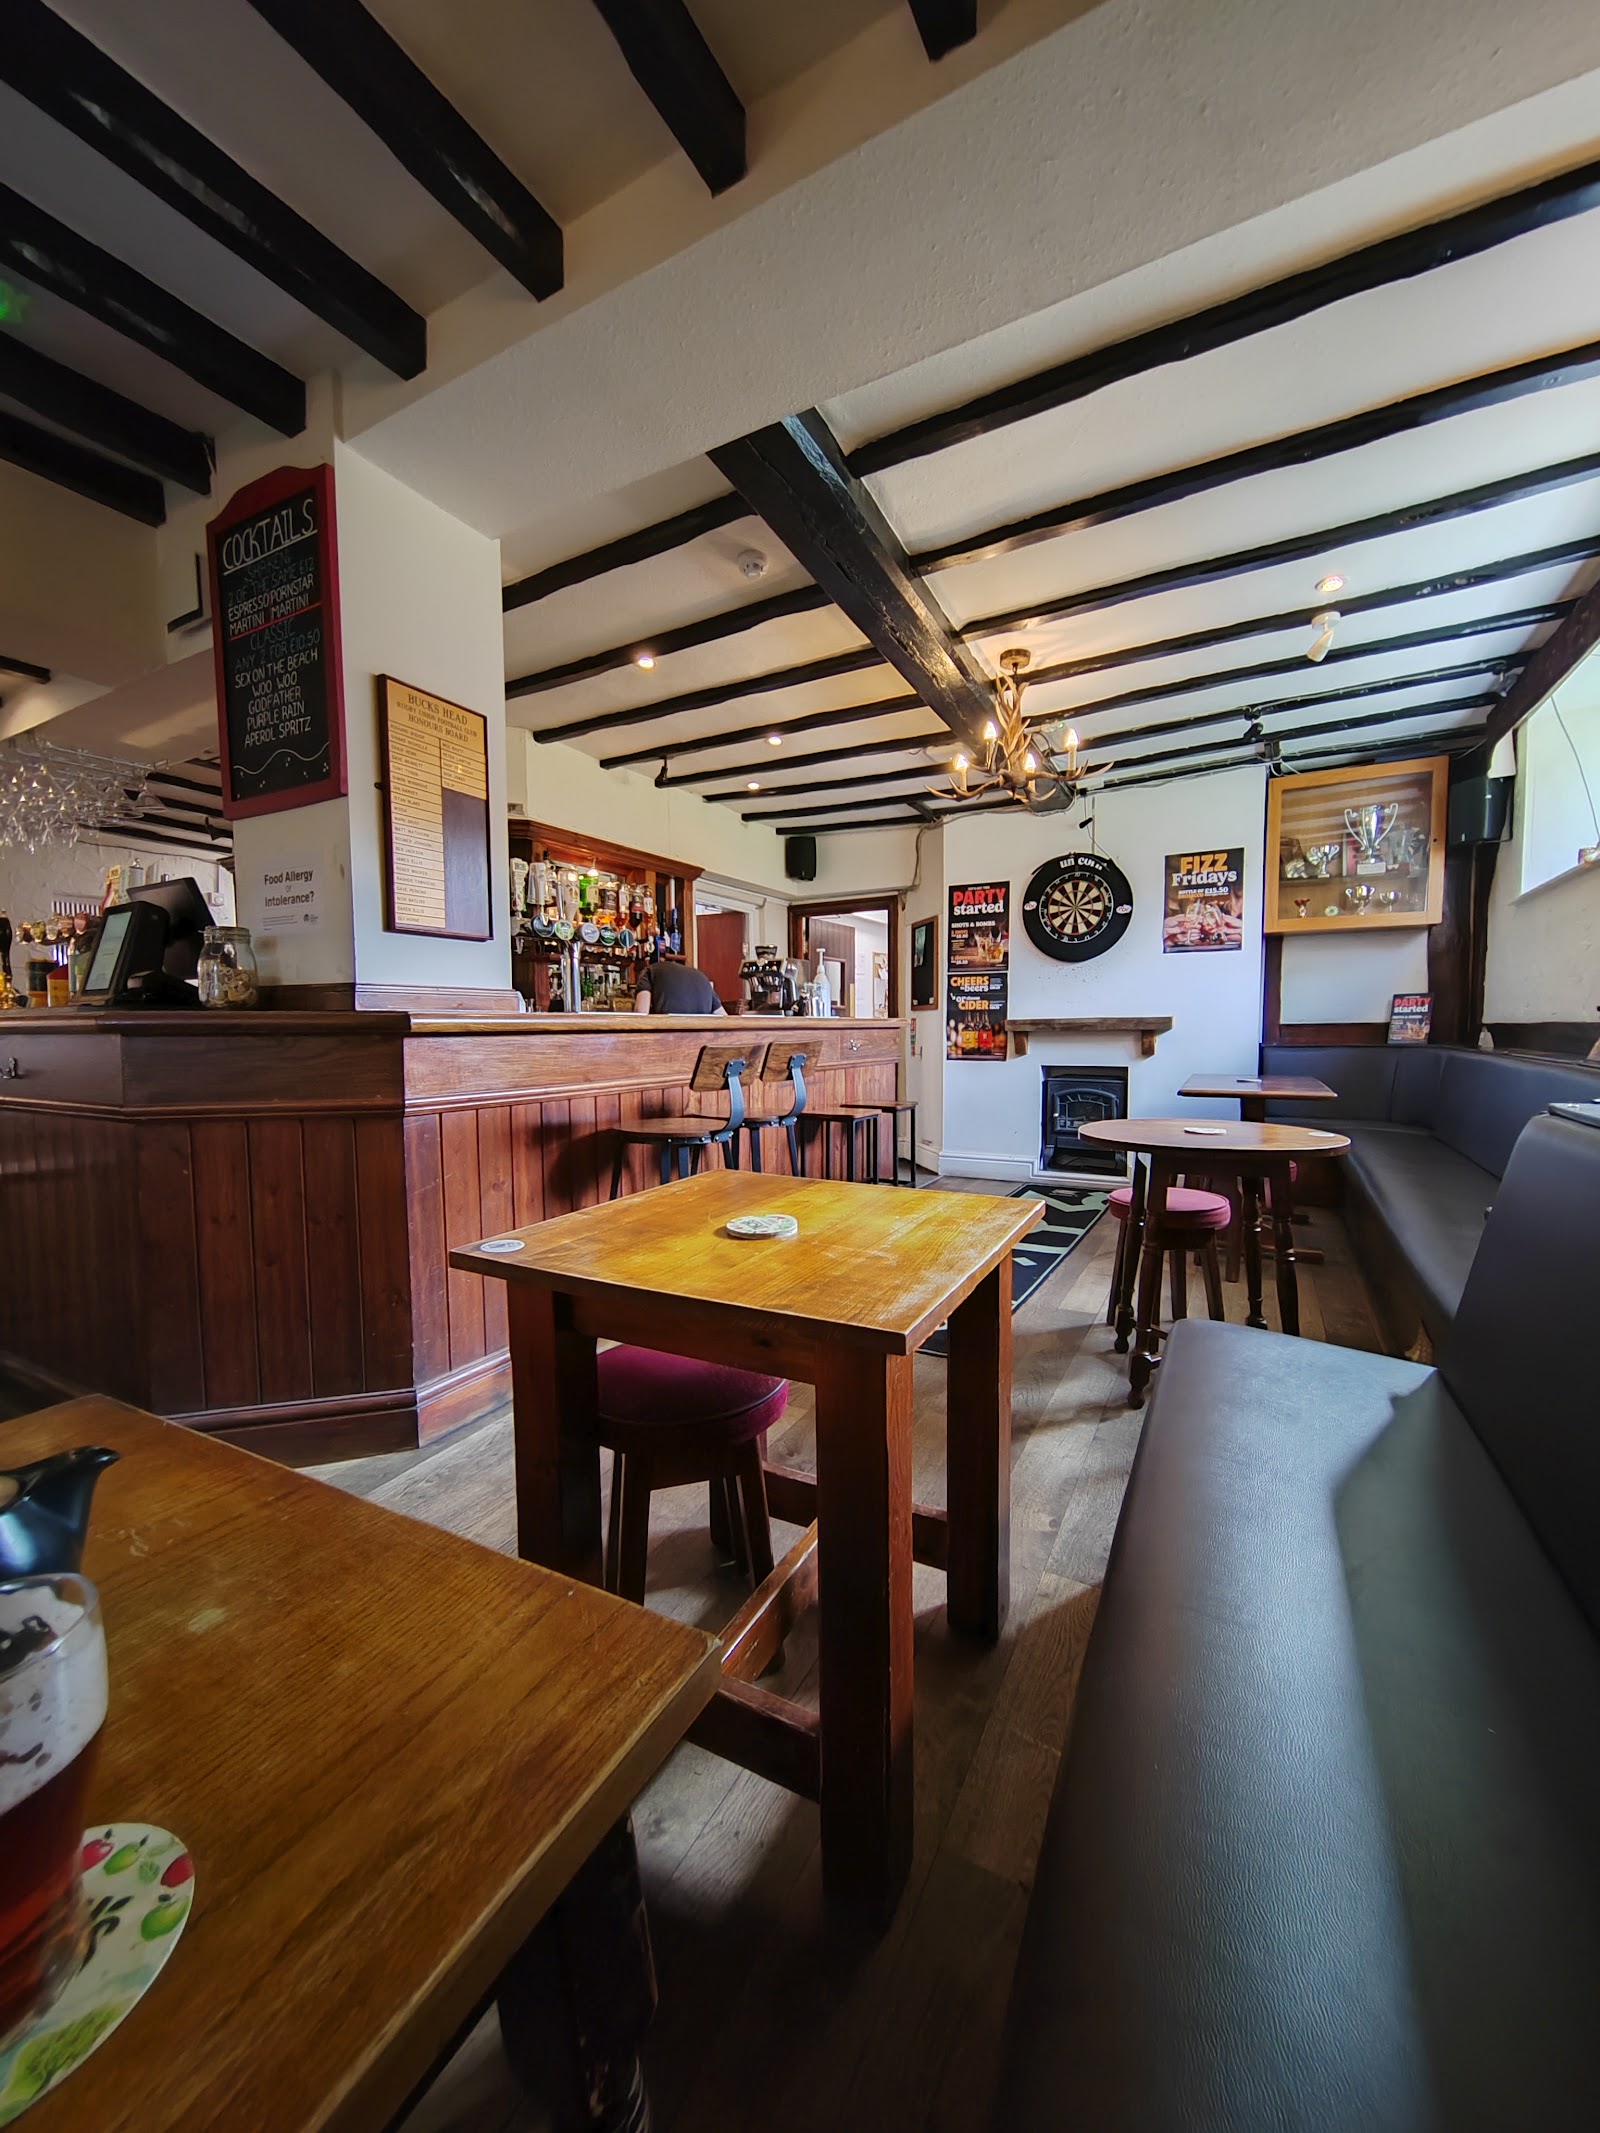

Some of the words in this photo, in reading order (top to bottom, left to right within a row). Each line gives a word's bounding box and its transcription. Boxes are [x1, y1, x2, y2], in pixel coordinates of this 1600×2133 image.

[223, 498, 314, 570] COCKTAILS
[228, 592, 270, 621] ESPRESSO
[270, 573, 314, 604] PORNSTAR
[229, 610, 265, 636] MARTINI
[271, 592, 309, 621] MARTINI
[250, 618, 296, 651] CLASSIC
[235, 653, 255, 673] ANY
[260, 649, 267, 665] 2
[270, 641, 288, 659] FOR
[235, 673, 251, 689] SEX
[252, 665, 265, 682] ON
[267, 658, 286, 677] THE
[287, 647, 318, 671] BEACH
[252, 680, 272, 698] WOO
[276, 671, 298, 689] WOO
[248, 686, 302, 715] GODFATHER
[408, 693, 440, 714] BUCKS
[442, 707, 468, 726] HEAD
[247, 708, 280, 731] PURPLE
[281, 700, 305, 720] RAIN
[244, 727, 276, 749] APEROL
[278, 716, 312, 739] SPRITZ
[408, 713, 444, 734] HONOURS
[445, 727, 469, 743] BOARD
[437, 717, 463, 732] FOOTBALL
[463, 728, 477, 737] CLUB
[1180, 853, 1228, 874] FIZZ
[264, 873, 283, 885] Food
[285, 870, 313, 882] Allergy
[1172, 870, 1237, 886] Fridays
[265, 890, 315, 907] Intolerance?
[953, 887, 1006, 906] PARTY
[953, 899, 1004, 916] started
[951, 921, 969, 929] SHOTS
[950, 976, 989, 986] CHEERS
[964, 984, 989, 992] beers
[958, 1000, 989, 1010] CIDER
[1394, 997, 1431, 1006] PARTY
[1394, 1004, 1429, 1013] started
